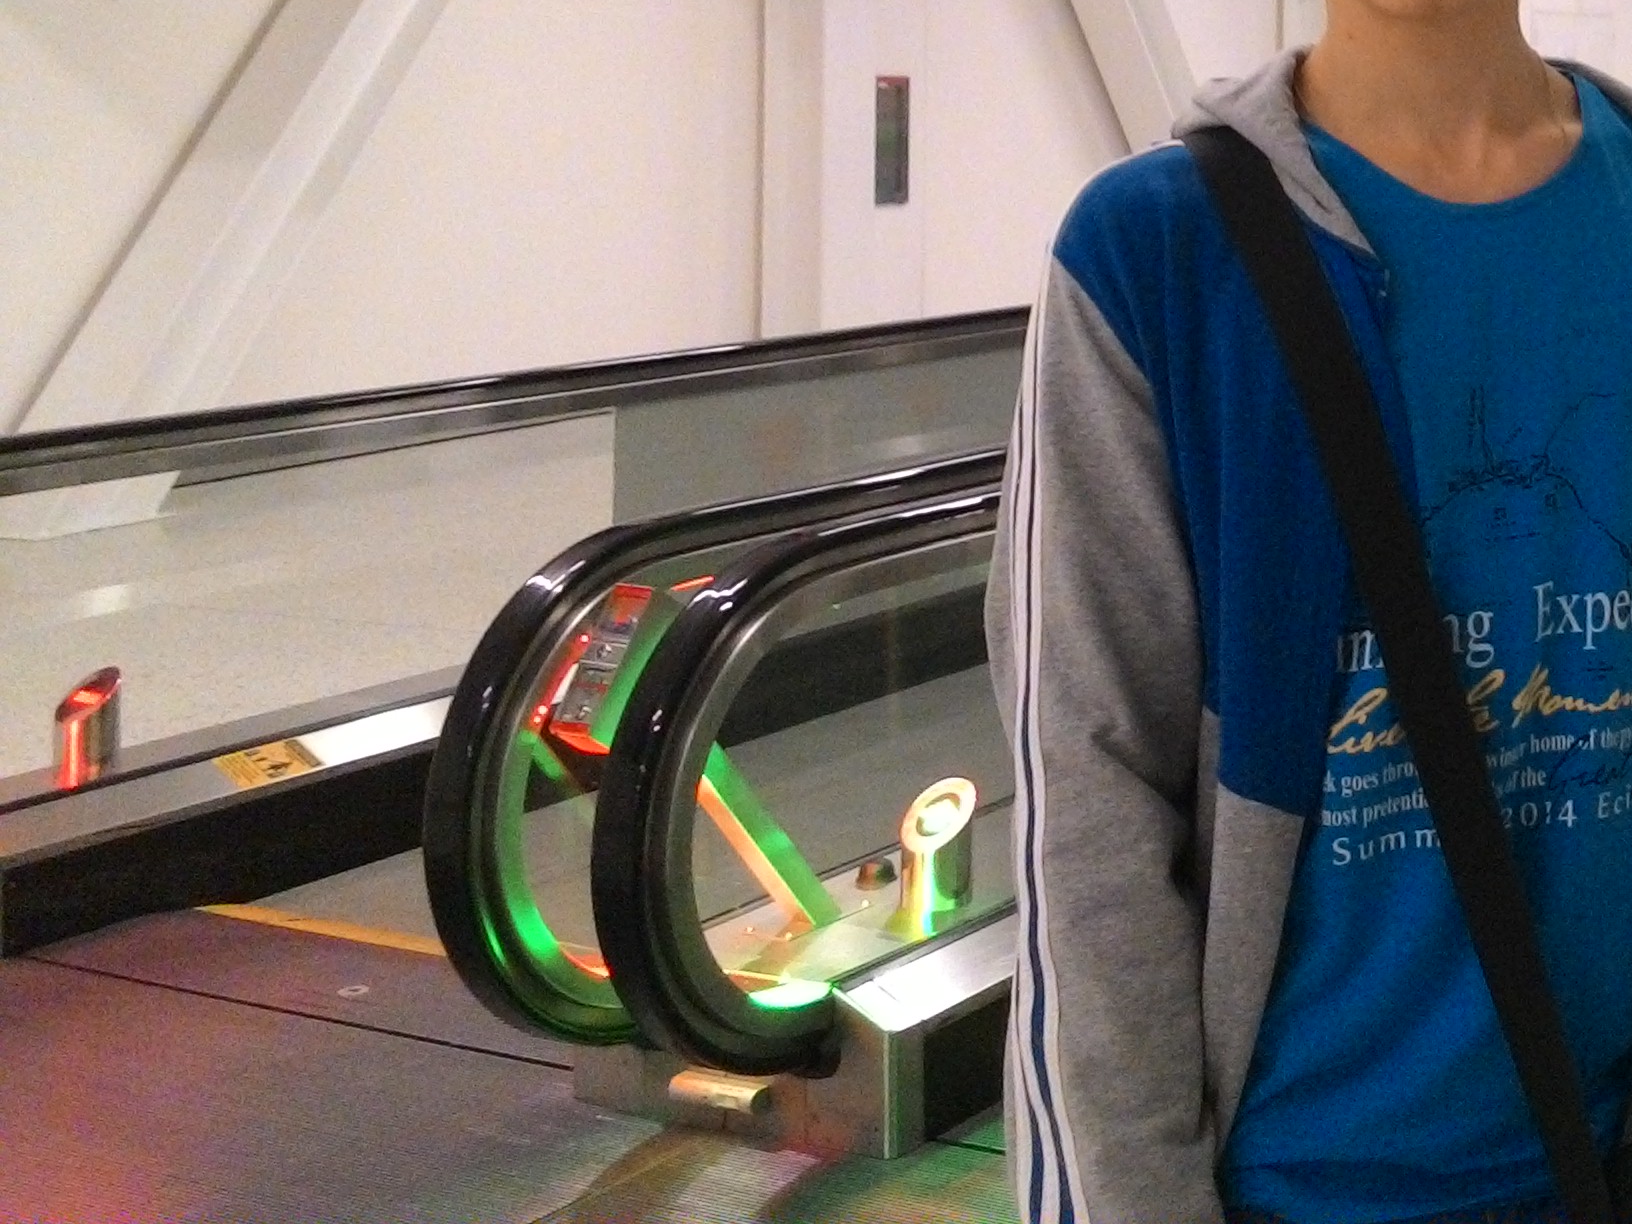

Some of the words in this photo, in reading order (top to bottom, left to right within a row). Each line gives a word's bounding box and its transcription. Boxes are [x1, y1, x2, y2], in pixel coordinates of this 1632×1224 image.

[1341, 772, 1379, 798] goes
[1530, 733, 1575, 754] home
[1519, 765, 1547, 789] the
[1331, 828, 1442, 866] Summ
